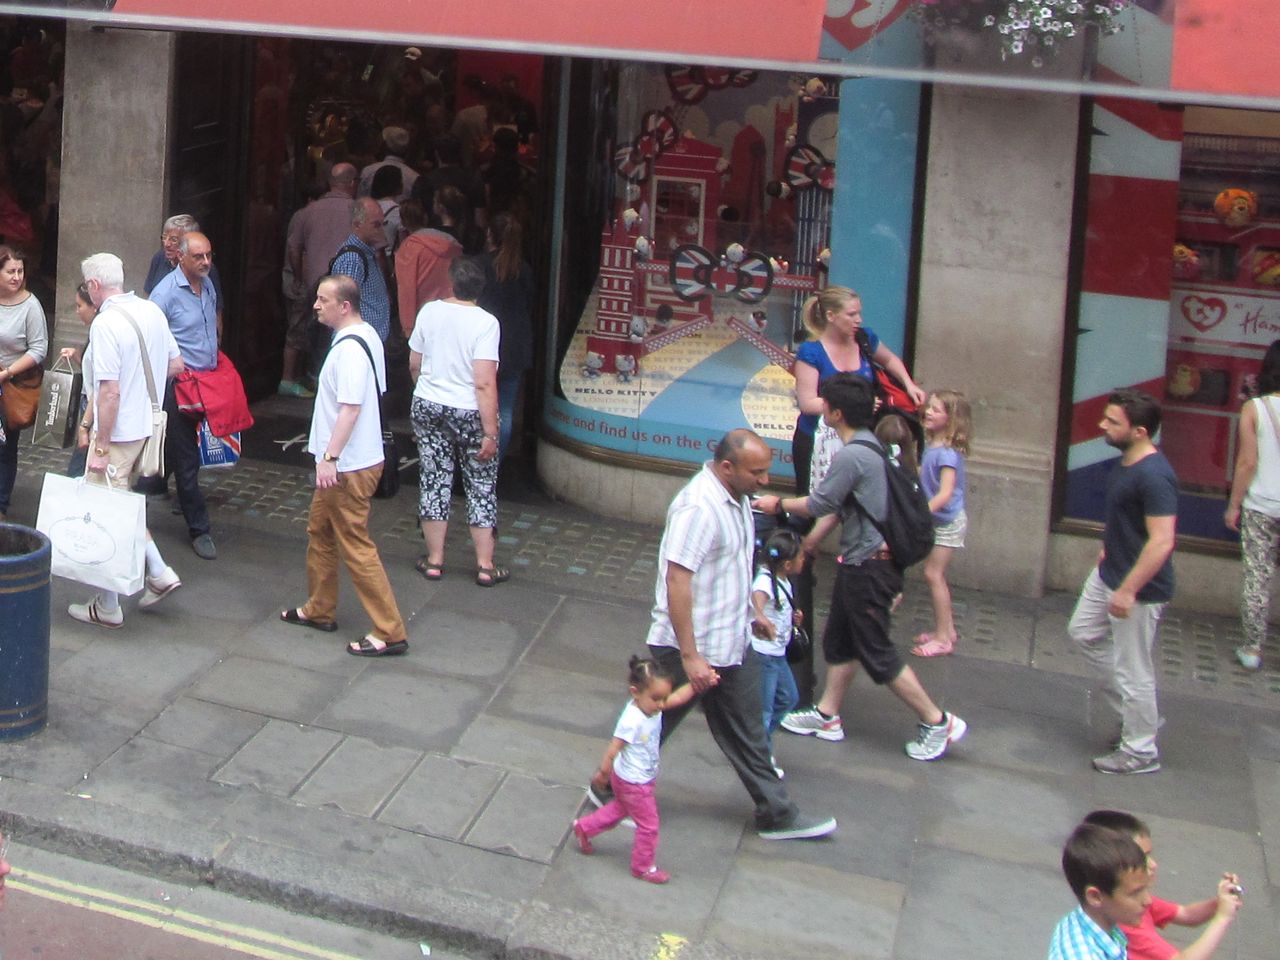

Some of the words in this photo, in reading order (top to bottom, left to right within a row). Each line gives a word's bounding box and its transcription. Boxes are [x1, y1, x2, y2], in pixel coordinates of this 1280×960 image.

[574, 387, 614, 395] HELLO
[619, 389, 658, 397] KITTY
[753, 423, 795, 431] HELLO
[573, 416, 595, 432] and
[600, 422, 627, 439] find
[632, 429, 648, 441] us
[652, 433, 672, 444] on
[676, 434, 702, 450] the
[770, 448, 794, 464] Flo
